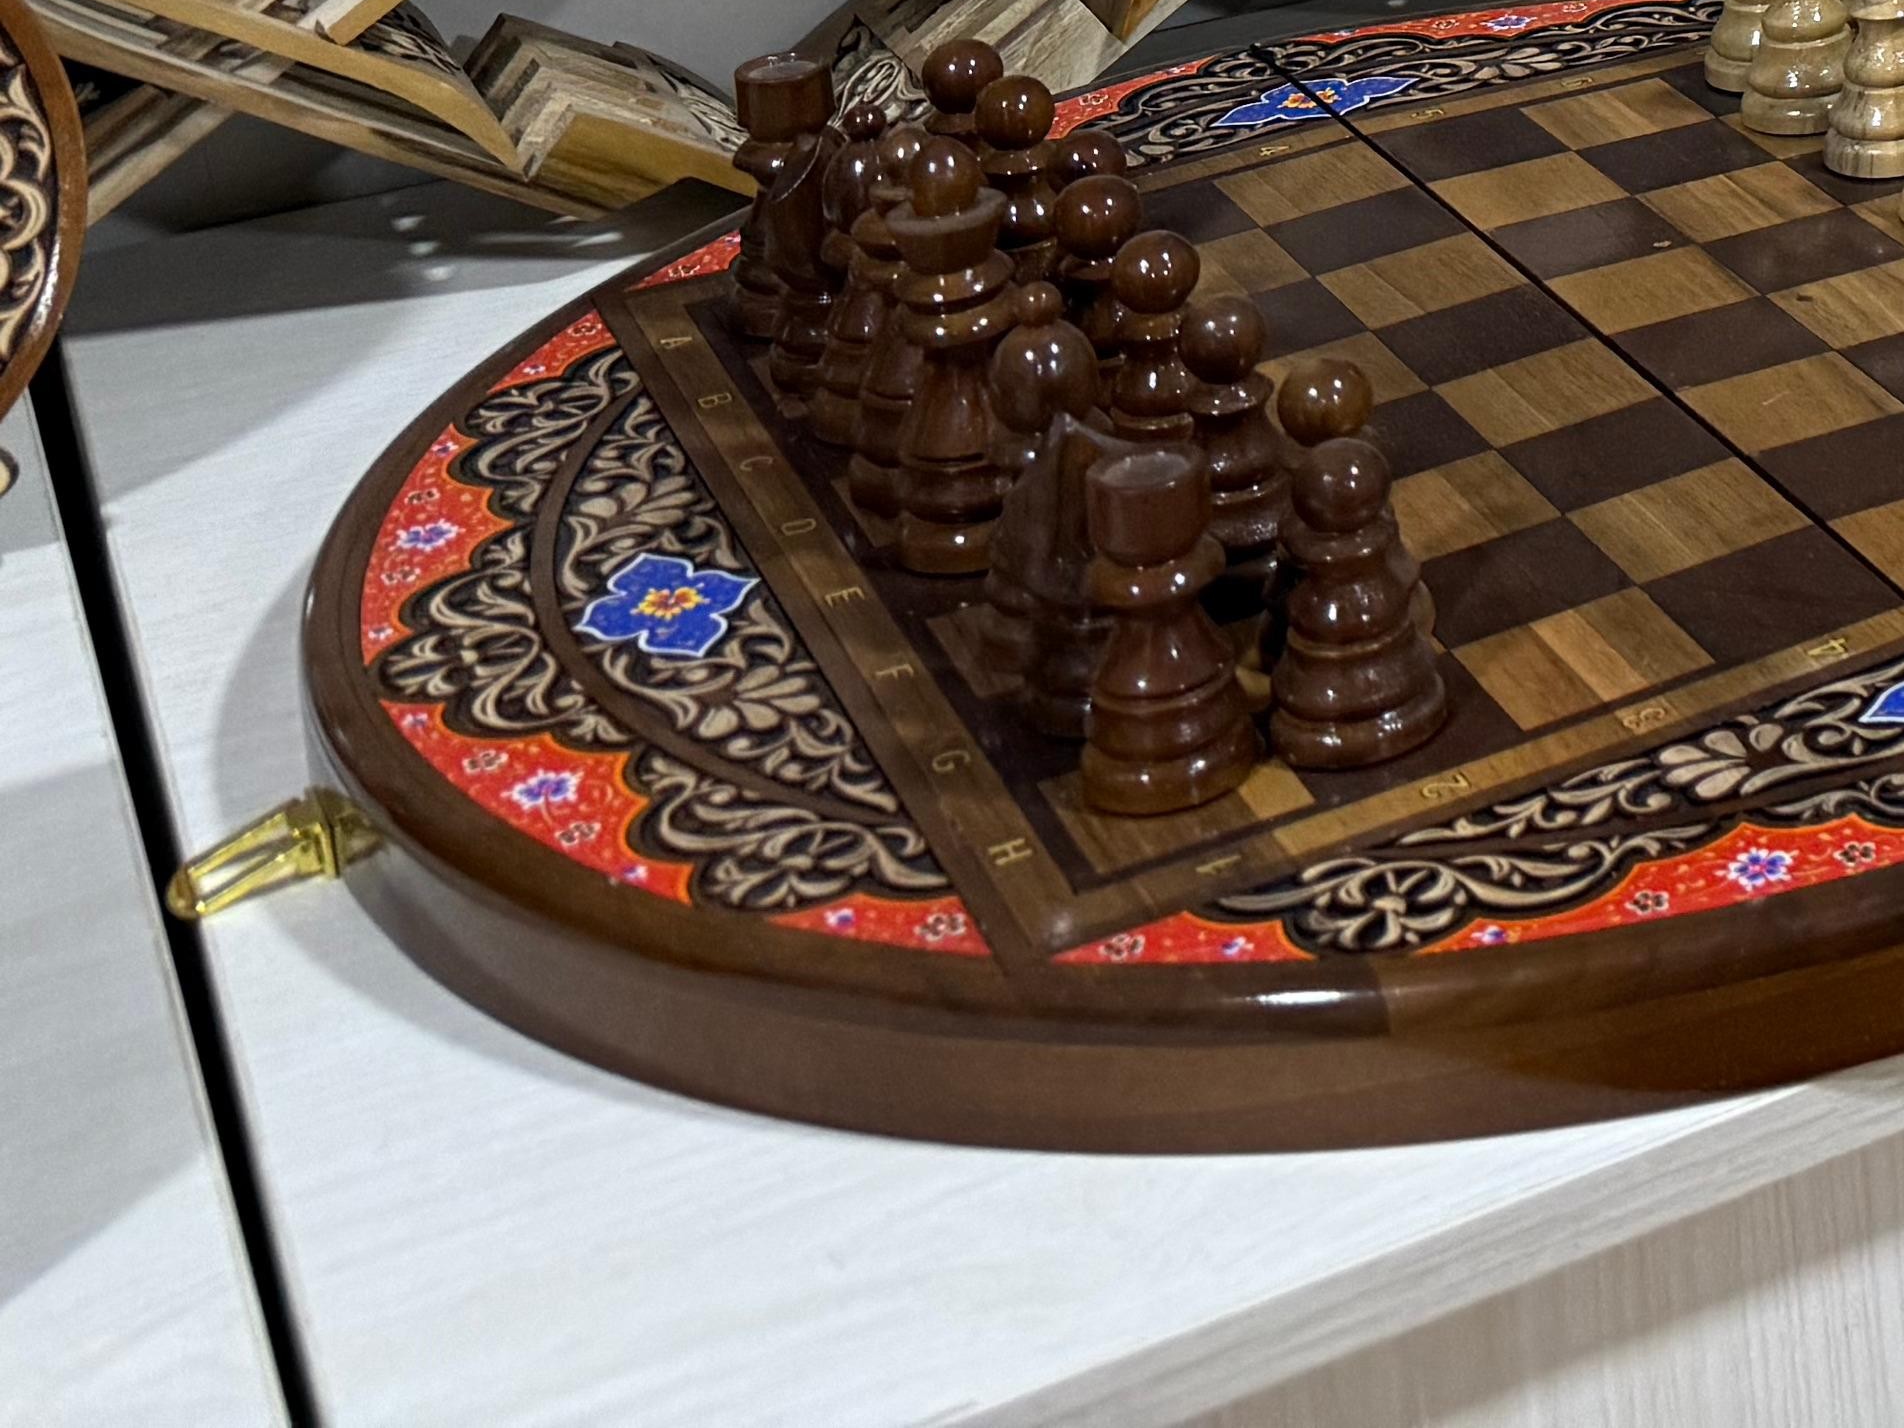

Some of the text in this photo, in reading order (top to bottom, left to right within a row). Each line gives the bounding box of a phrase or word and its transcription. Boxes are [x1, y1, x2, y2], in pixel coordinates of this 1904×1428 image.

[698, 392, 732, 408] B
[740, 456, 774, 471] C
[824, 586, 865, 608] E
[875, 663, 914, 679] F
[932, 750, 971, 773] G
[988, 837, 1033, 866] H
[1420, 771, 1472, 800] 2
[1622, 707, 1666, 732] 3
[1807, 637, 1850, 658] 4
